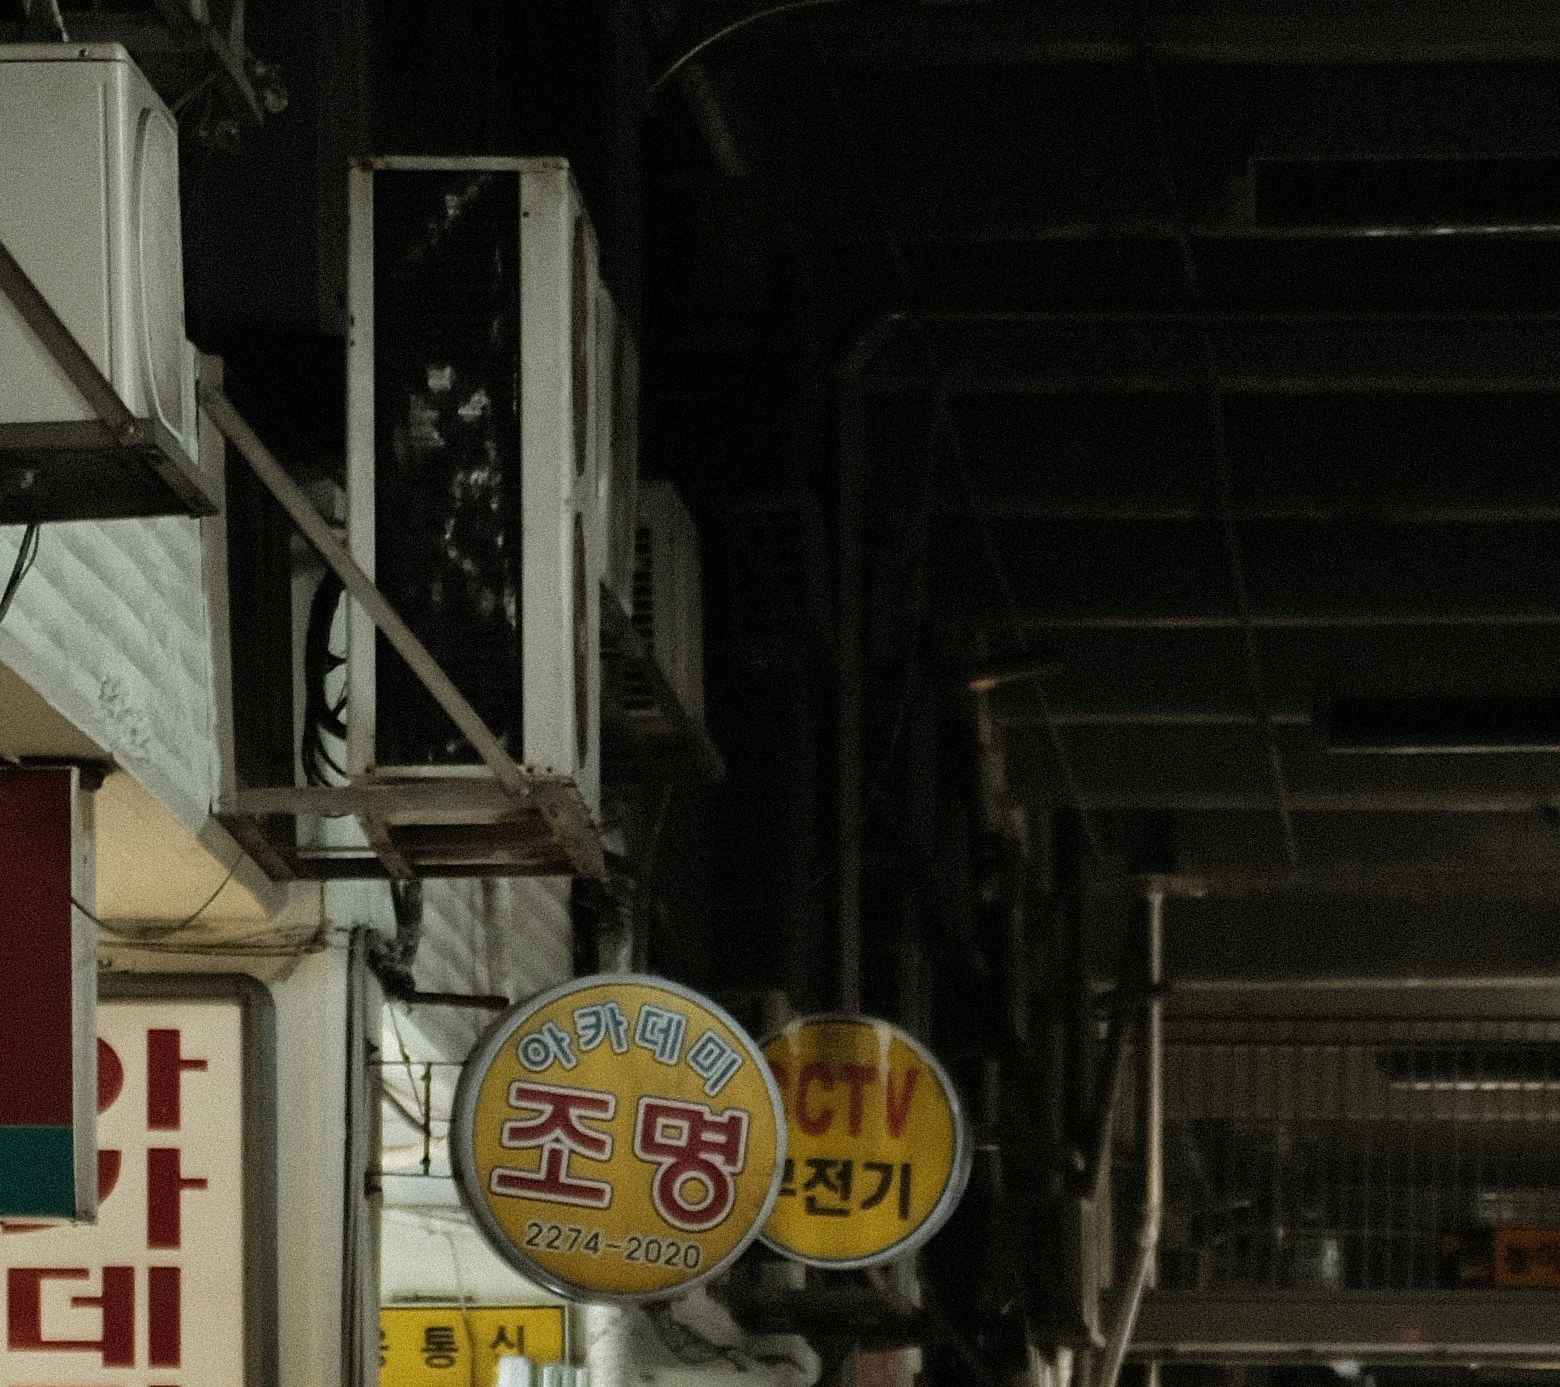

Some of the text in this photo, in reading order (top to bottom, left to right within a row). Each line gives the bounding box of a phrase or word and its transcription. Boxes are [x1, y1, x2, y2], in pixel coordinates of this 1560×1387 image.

[517, 1001, 743, 1097] 아카데미
[489, 1079, 749, 1233] 조명
[780, 1157, 913, 1221] 전기
[524, 1221, 702, 1270] 2274-2020
